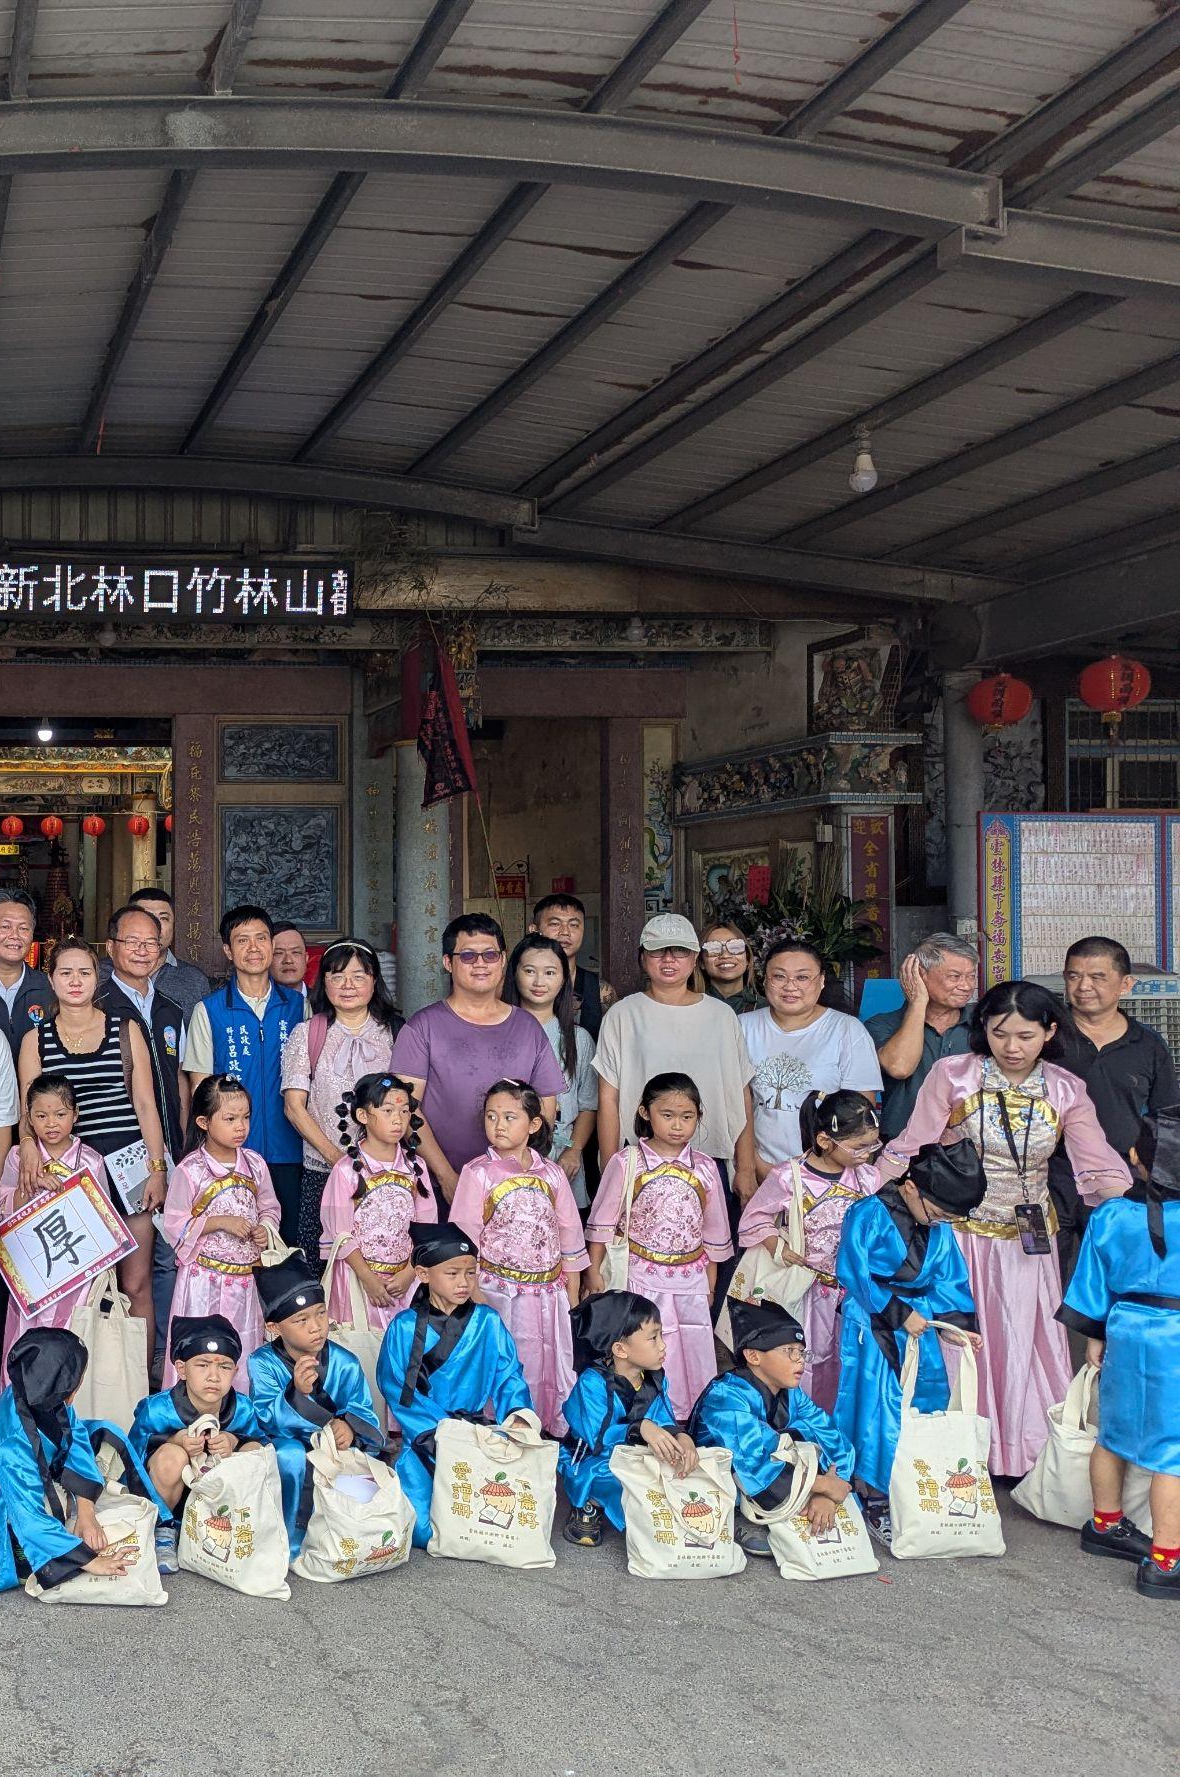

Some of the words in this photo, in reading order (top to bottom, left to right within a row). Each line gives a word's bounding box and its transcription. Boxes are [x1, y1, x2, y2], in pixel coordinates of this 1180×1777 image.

[239, 1025, 251, 1056] 民政處
[32, 1208, 87, 1279] 厚
